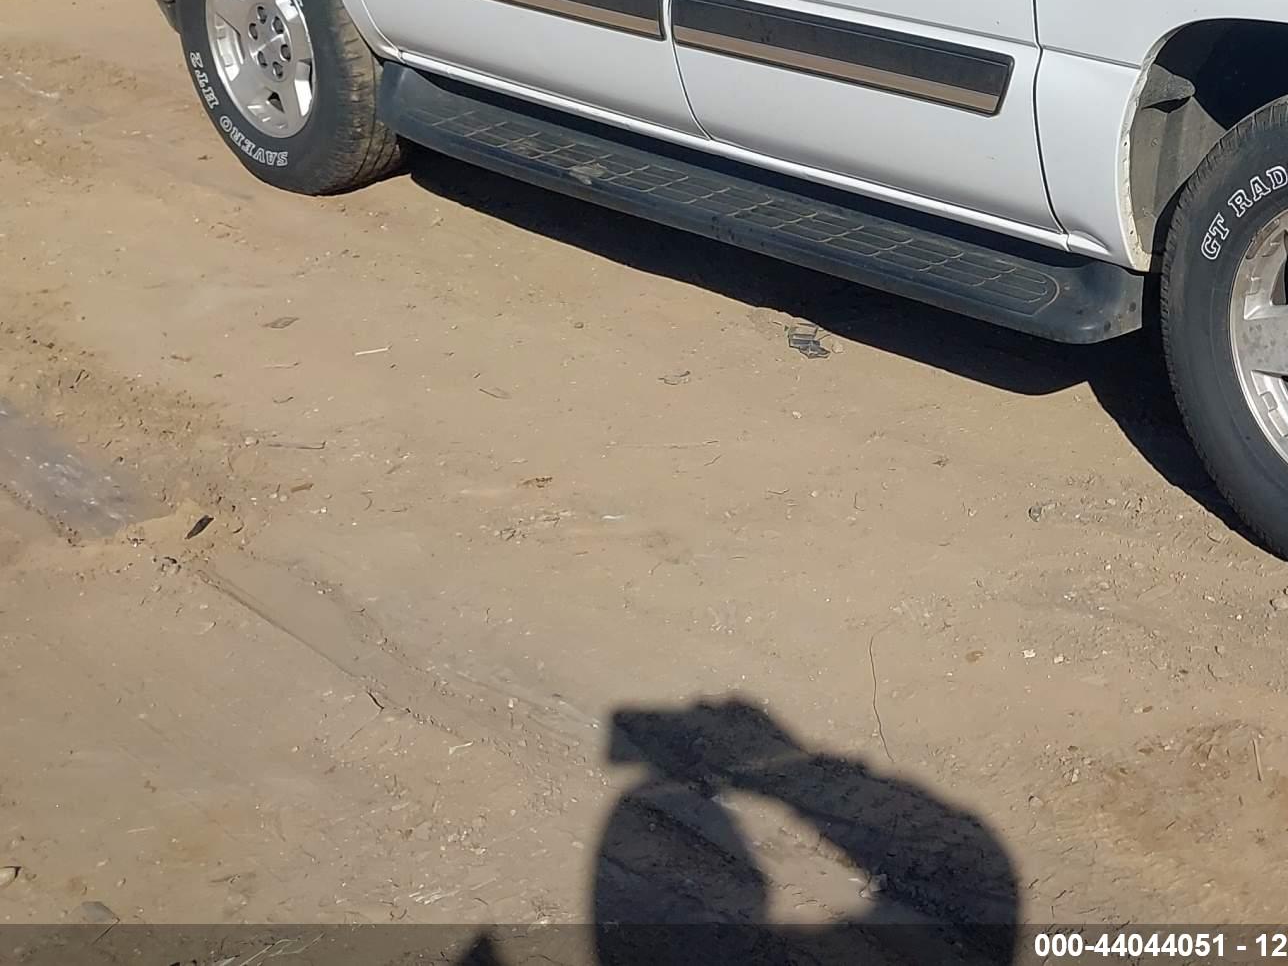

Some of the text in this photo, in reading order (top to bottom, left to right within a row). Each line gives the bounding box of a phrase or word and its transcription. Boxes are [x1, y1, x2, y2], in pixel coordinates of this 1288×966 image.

[190, 52, 289, 167] SAVERO HT2
[1201, 212, 1230, 260] GT
